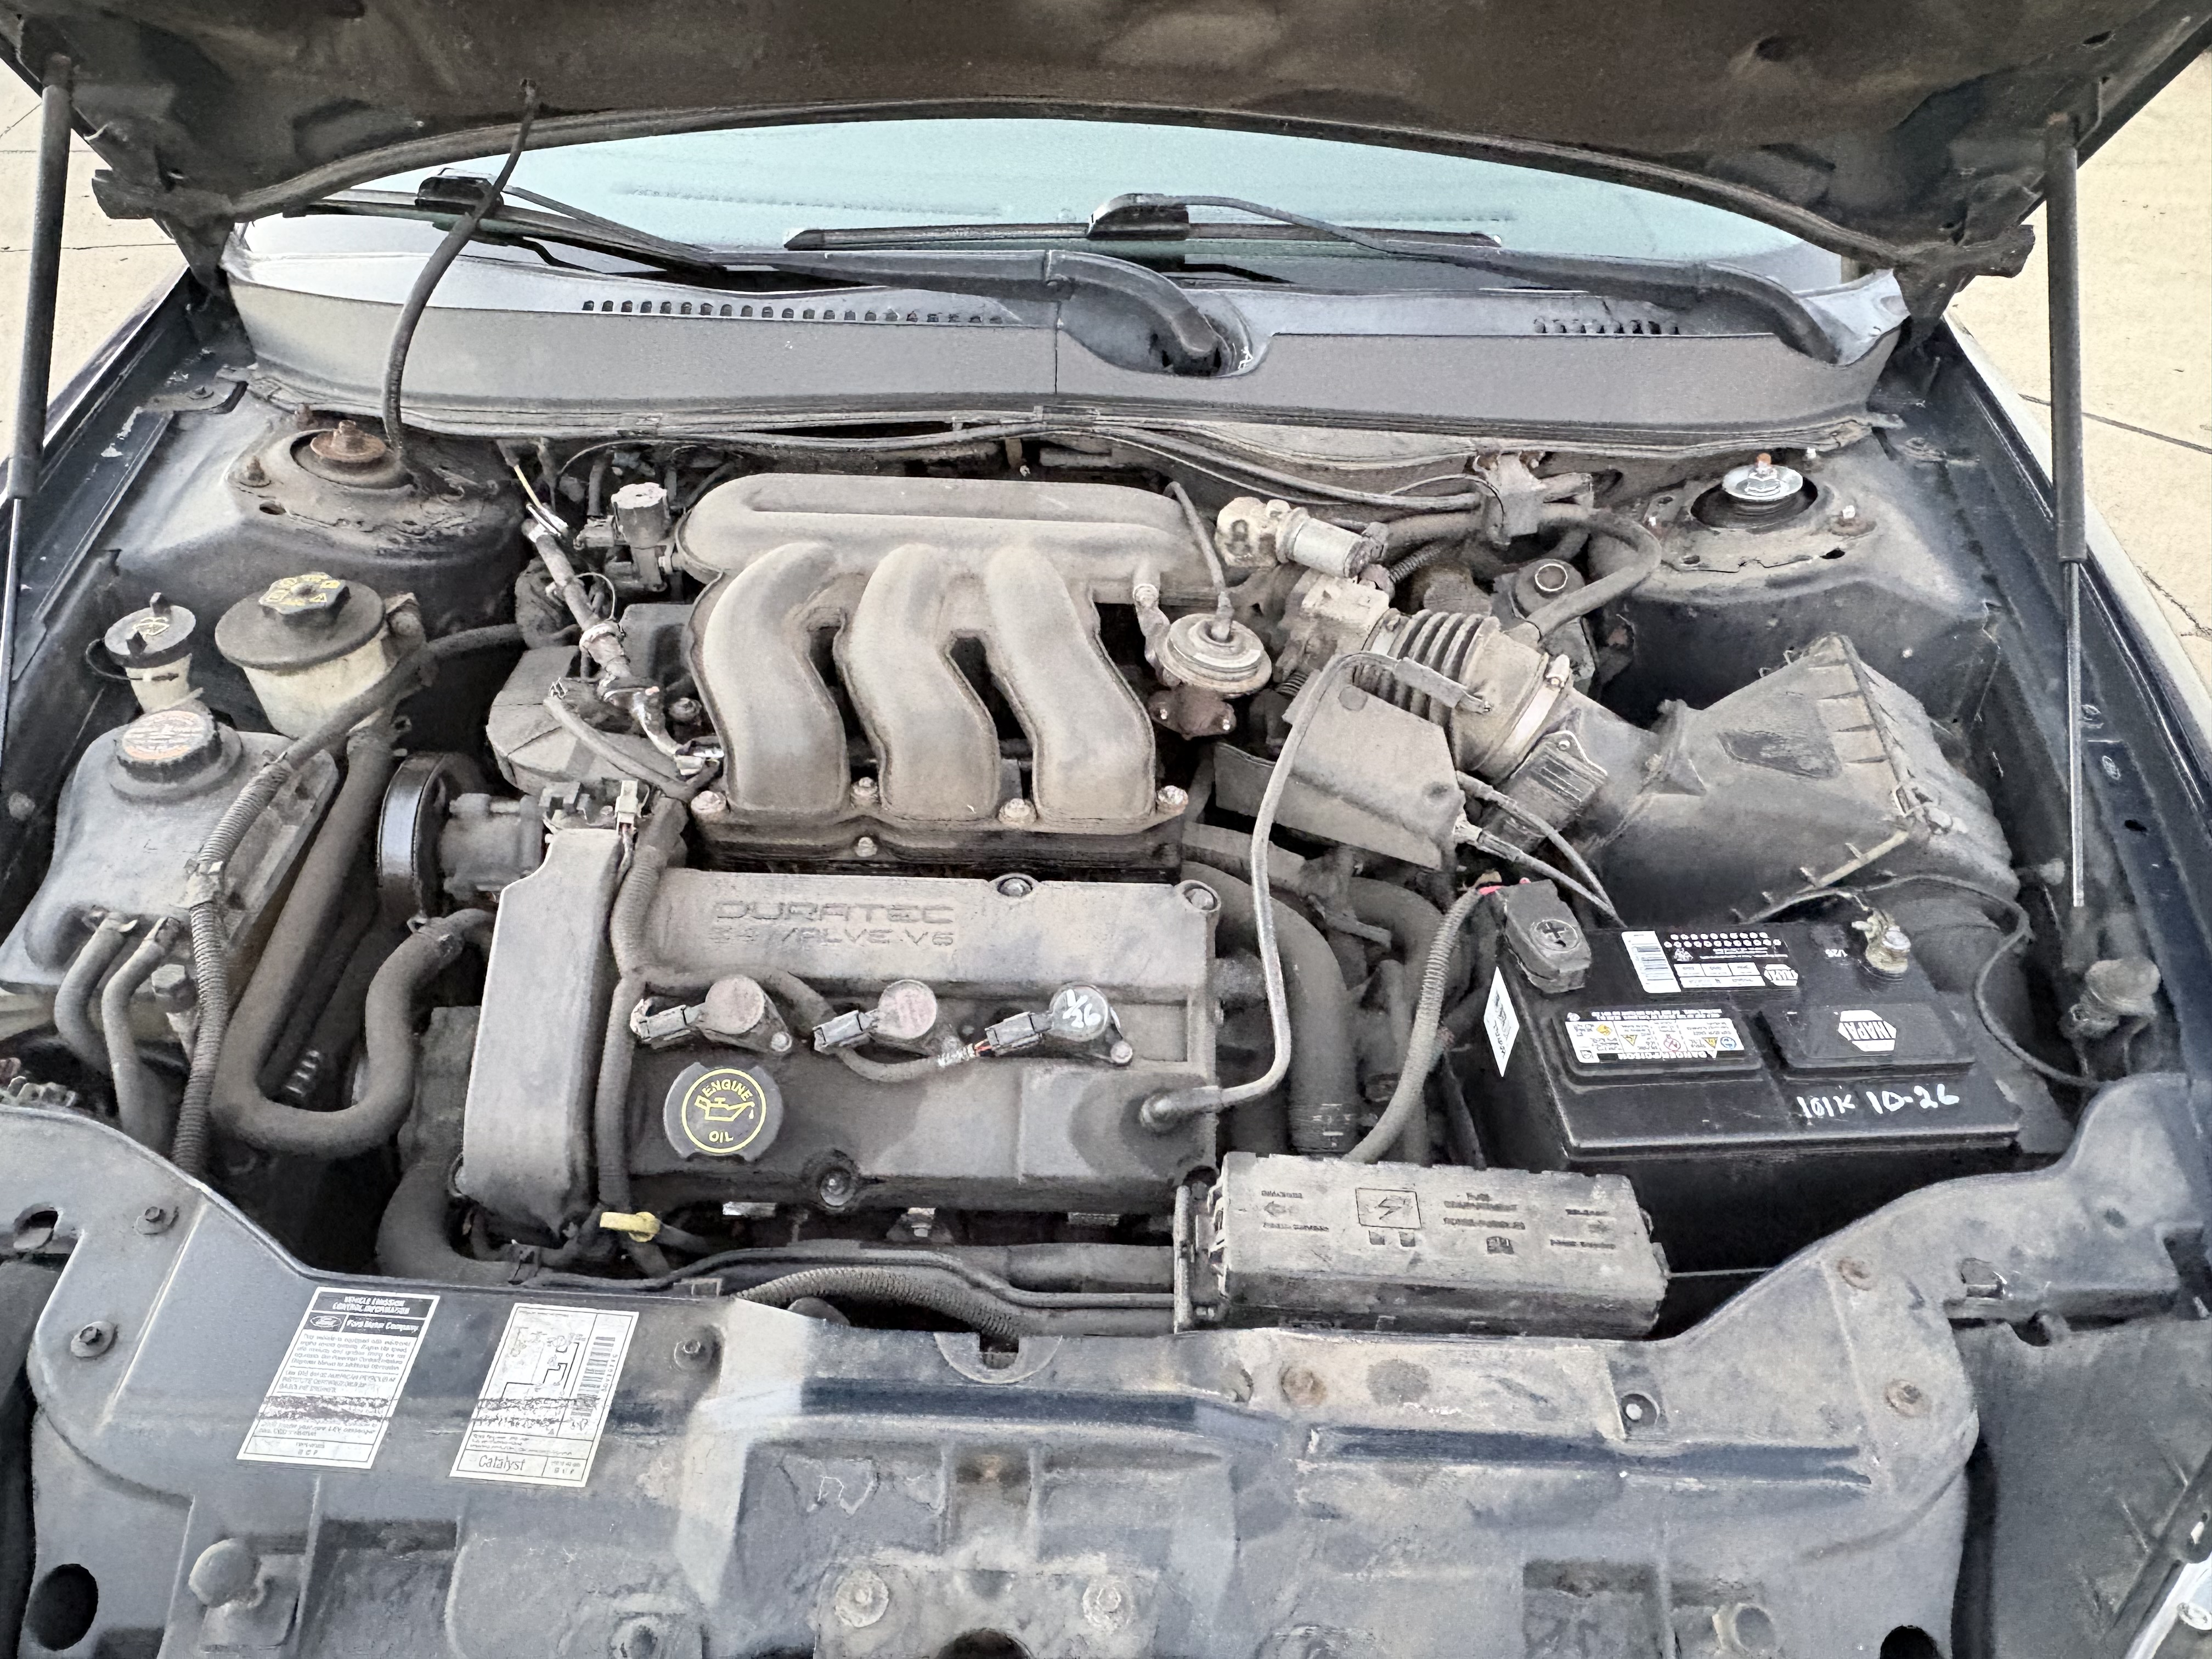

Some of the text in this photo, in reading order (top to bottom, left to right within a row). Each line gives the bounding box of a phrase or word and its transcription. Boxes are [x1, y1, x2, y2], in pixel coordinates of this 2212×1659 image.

[715, 901, 953, 923] DURATEC
[905, 929, 954, 946] V6
[1843, 1020, 1893, 1040] NAPA
[702, 1079, 753, 1102] ENGINE
[709, 1130, 734, 1143] OIL
[385, 1321, 420, 1334] Company
[478, 1454, 526, 1472] Catalyst
